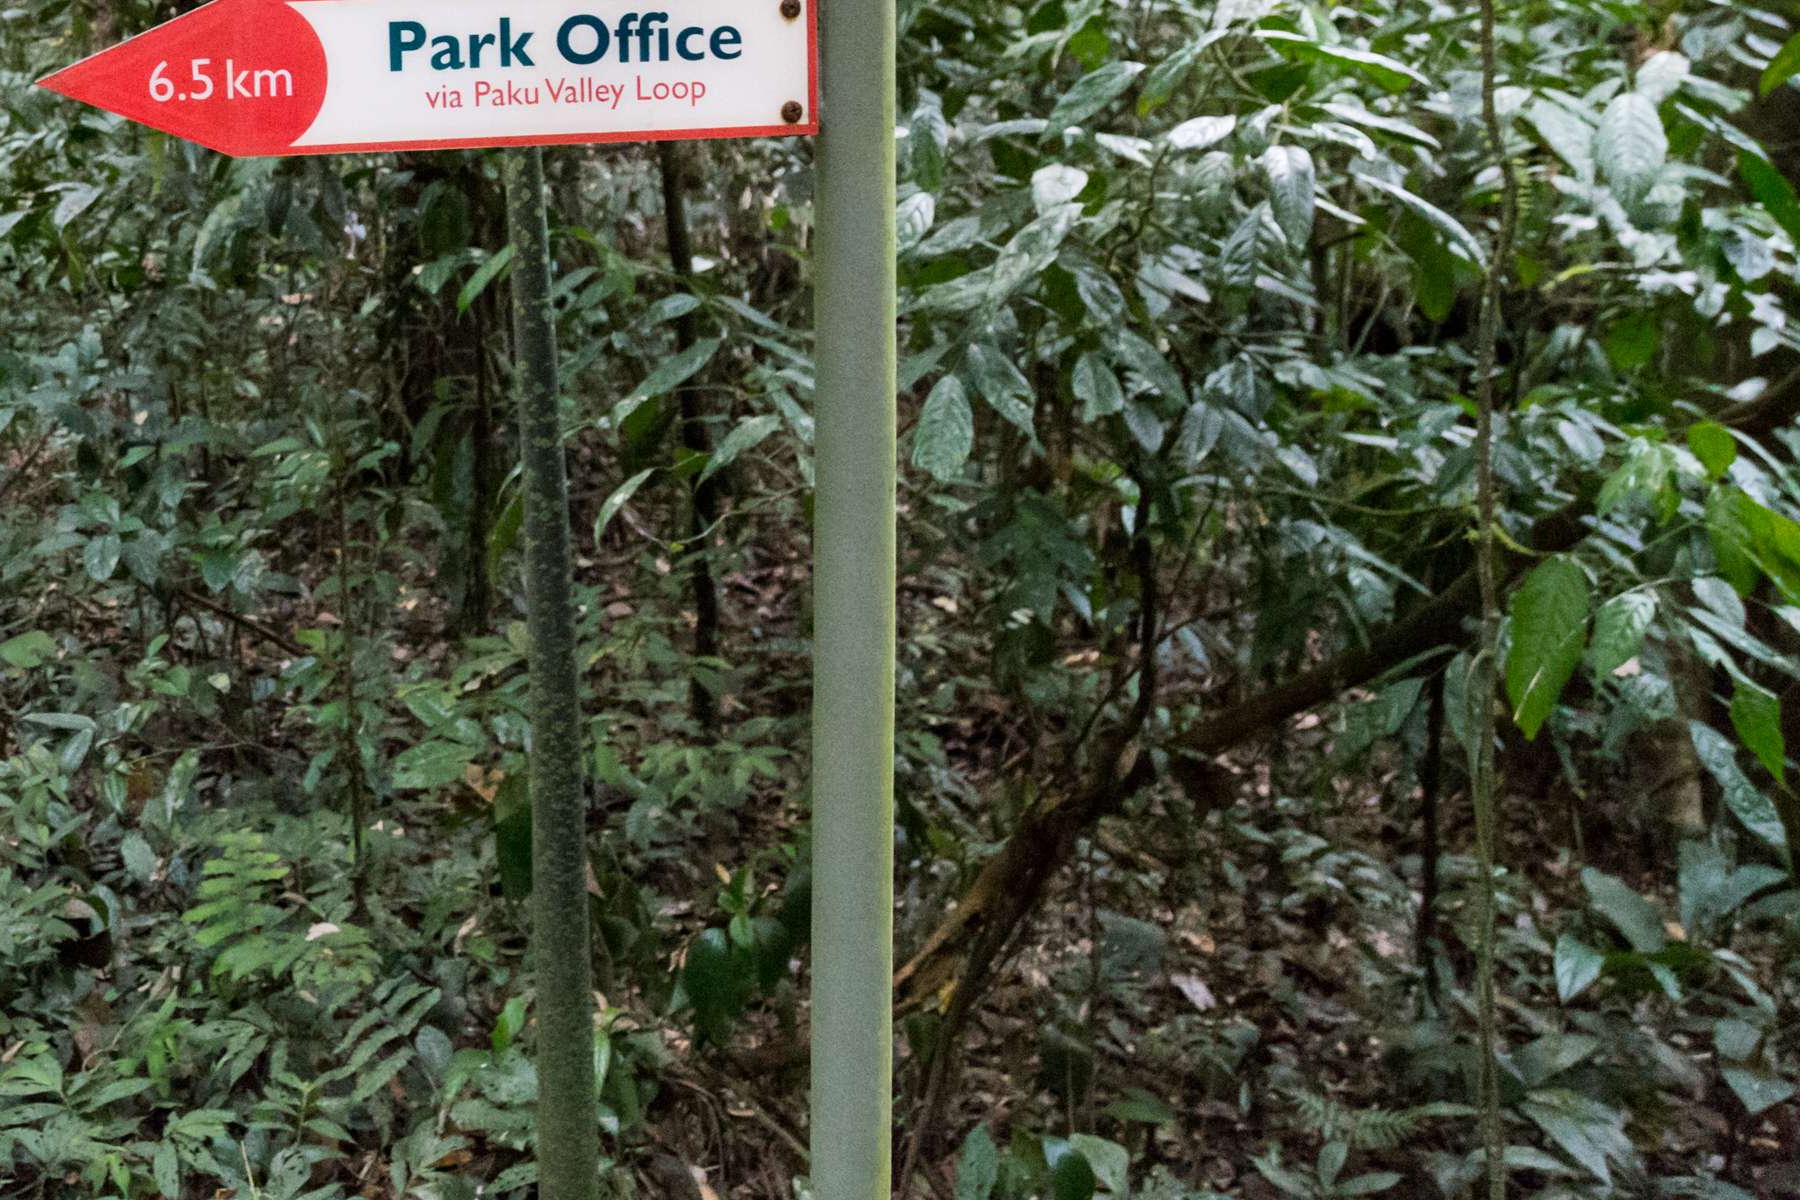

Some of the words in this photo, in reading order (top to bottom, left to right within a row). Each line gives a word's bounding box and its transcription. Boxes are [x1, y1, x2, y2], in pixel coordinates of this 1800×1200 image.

[388, 16, 536, 73] Park
[556, 11, 743, 66] Office
[148, 58, 214, 102] 6.5
[225, 58, 293, 100] km
[425, 84, 464, 109] via
[474, 79, 540, 108] Paku
[544, 76, 625, 110] Valley
[636, 74, 707, 107] Loop
